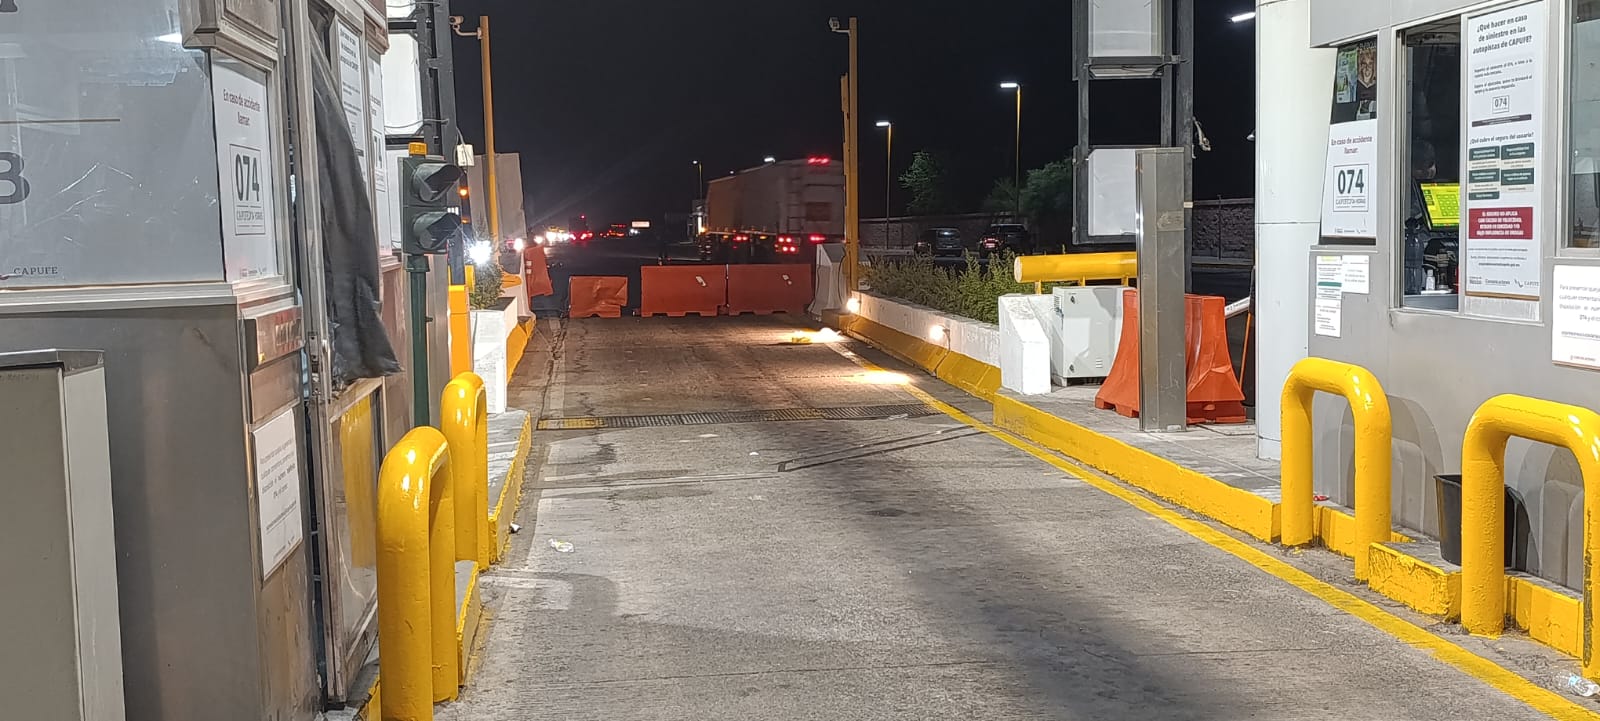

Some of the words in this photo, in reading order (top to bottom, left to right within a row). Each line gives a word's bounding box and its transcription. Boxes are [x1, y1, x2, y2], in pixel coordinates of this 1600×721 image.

[1491, 19, 1506, 28] hacer
[1507, 17, 1514, 25] en
[1485, 29, 1509, 41] siniestro
[1473, 42, 1500, 54] autopistas
[1494, 98, 1507, 108] 074
[1352, 136, 1372, 144] accidente
[235, 153, 260, 202] 074
[1337, 168, 1364, 194] 074
[13, 266, 58, 275] CAPUFE
